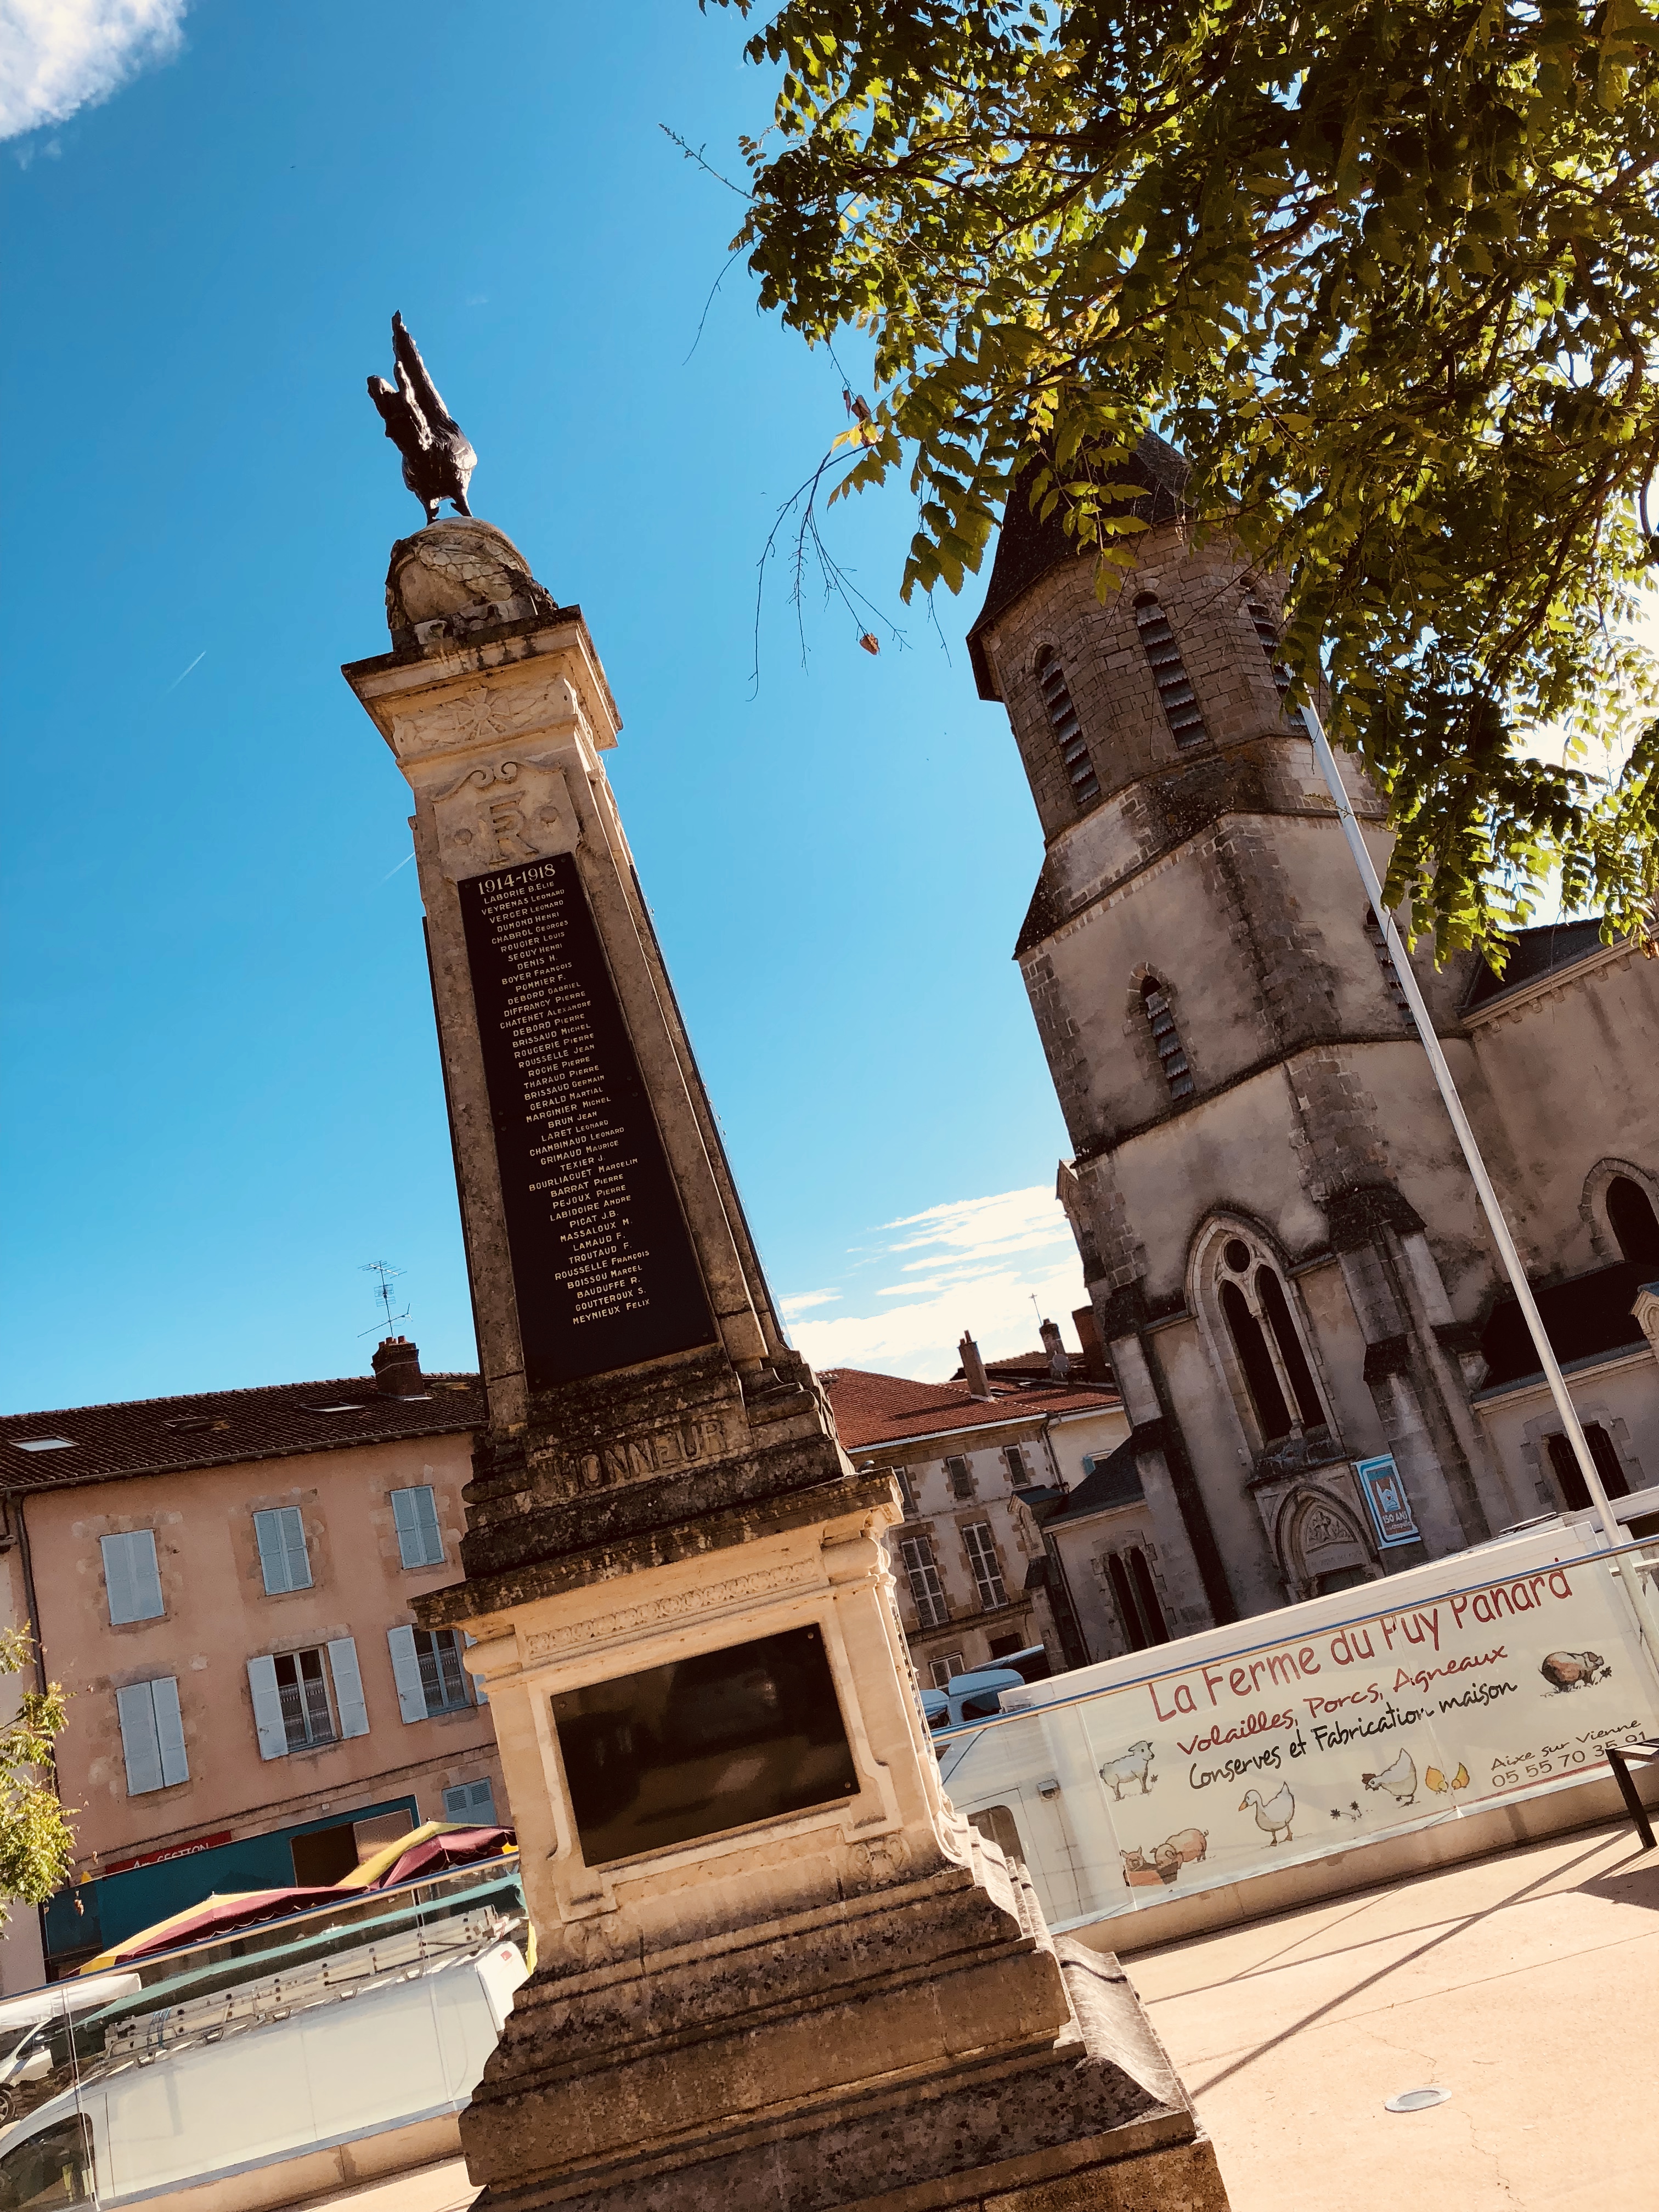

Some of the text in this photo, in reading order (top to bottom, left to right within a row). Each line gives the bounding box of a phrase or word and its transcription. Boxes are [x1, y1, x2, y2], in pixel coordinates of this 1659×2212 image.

[478, 864, 555, 895] 1914-1918
[482, 889, 564, 915] VEYRENAS LEONARD
[484, 888, 525, 904] LABORIE
[489, 900, 563, 923] VERGER LEONARD
[497, 912, 559, 932] DUMOND HENRI
[492, 921, 568, 944] CHABROL GEORGES
[500, 932, 565, 952] ROUGIER LOUIS
[508, 943, 562, 961] SEGUY HENRI
[501, 962, 572, 985] BOYER FRANÇOIS
[517, 958, 544, 970] DENIS
[508, 982, 581, 1005] DEBORD GABRIEL
[516, 977, 555, 992] POMMIER
[500, 1001, 591, 1029] CHATENET ALEXANDRE
[504, 991, 585, 1017] DIFFRANCY PIERRE
[512, 1024, 591, 1048] BRISSAUD MICHEL
[513, 1013, 585, 1036] DEBORD PIERRE
[514, 1033, 594, 1058] ROUGERIE PIERRE
[518, 1044, 594, 1068] ROUSSELLE JEAN
[523, 1065, 599, 1089] THARAUD PIERRE
[528, 1056, 590, 1077] ROCHE PIERRE
[524, 1075, 604, 1101] BRISSAUD GERMAIN
[530, 1087, 603, 1110] GERALD MARTIAL
[526, 1097, 611, 1122] MARGINIER MICHEL
[548, 1111, 597, 1128] BRUN JEAN
[530, 1127, 624, 1156] CHAMBINAUD LEONARD
[541, 1120, 608, 1142] LARET LEONARD
[540, 1140, 619, 1165] GRIMAUD MAURICE
[560, 1157, 594, 1171] TEXIER
[529, 1158, 637, 1191] BOURLIAGUET MARCELIN
[550, 1174, 623, 1197] BARRAT PIERRE
[552, 1184, 626, 1209] PEJOUX PIERRE
[603, 1195, 631, 1207] ANDRE
[560, 1222, 616, 1242] MASSALOUX
[569, 1215, 597, 1228] PICAT
[573, 1235, 612, 1251] LAMAUD
[555, 1250, 650, 1280] ROUSSELLE FRANÇOIS
[568, 1246, 617, 1264] TROUTAUD
[567, 1265, 642, 1289] BOISSOU MARCEL
[575, 1290, 633, 1311] GOUTTEROUX
[577, 1279, 625, 1299] BAUDUFFE
[573, 1299, 650, 1324] MEYNIEUX FELIX
[553, 1419, 727, 1499] HONNEUR
[1383, 1514, 1394, 1523] 150
[1148, 1557, 1573, 1722] La Ferme du Puy Panard
[1303, 1683, 1384, 1718] Porcs,
[1393, 1646, 1508, 1692] Agneaux
[1189, 1682, 1518, 1789] Conserves et Fabrication maison
[1491, 1720, 1641, 1771] Aixe sur Vienne
[1492, 1770, 1519, 1787] 05
[1525, 1759, 1553, 1778] 55
[1558, 1750, 1585, 1768] 70
